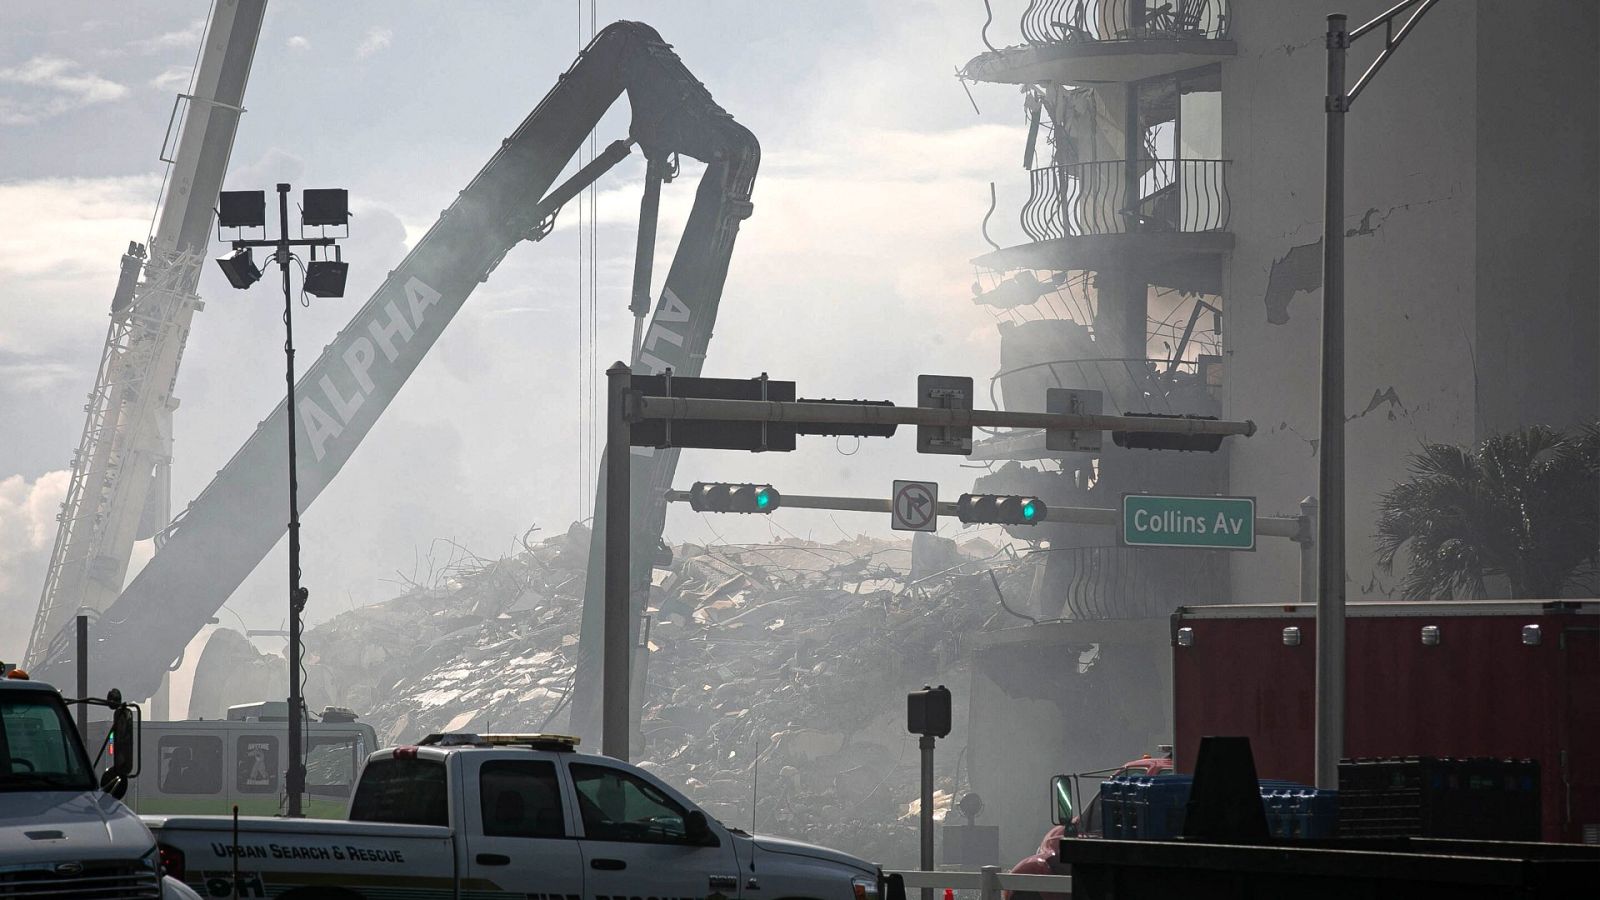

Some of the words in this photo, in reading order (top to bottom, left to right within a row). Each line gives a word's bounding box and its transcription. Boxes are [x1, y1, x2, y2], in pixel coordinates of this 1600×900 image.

[298, 276, 442, 463] ALPHA
[1134, 509, 1206, 534] Collins
[1213, 512, 1243, 535] Av
[212, 843, 267, 858] URBAN
[270, 843, 330, 860] SEARCH
[334, 846, 345, 860] &
[346, 846, 405, 863] RESCUE
